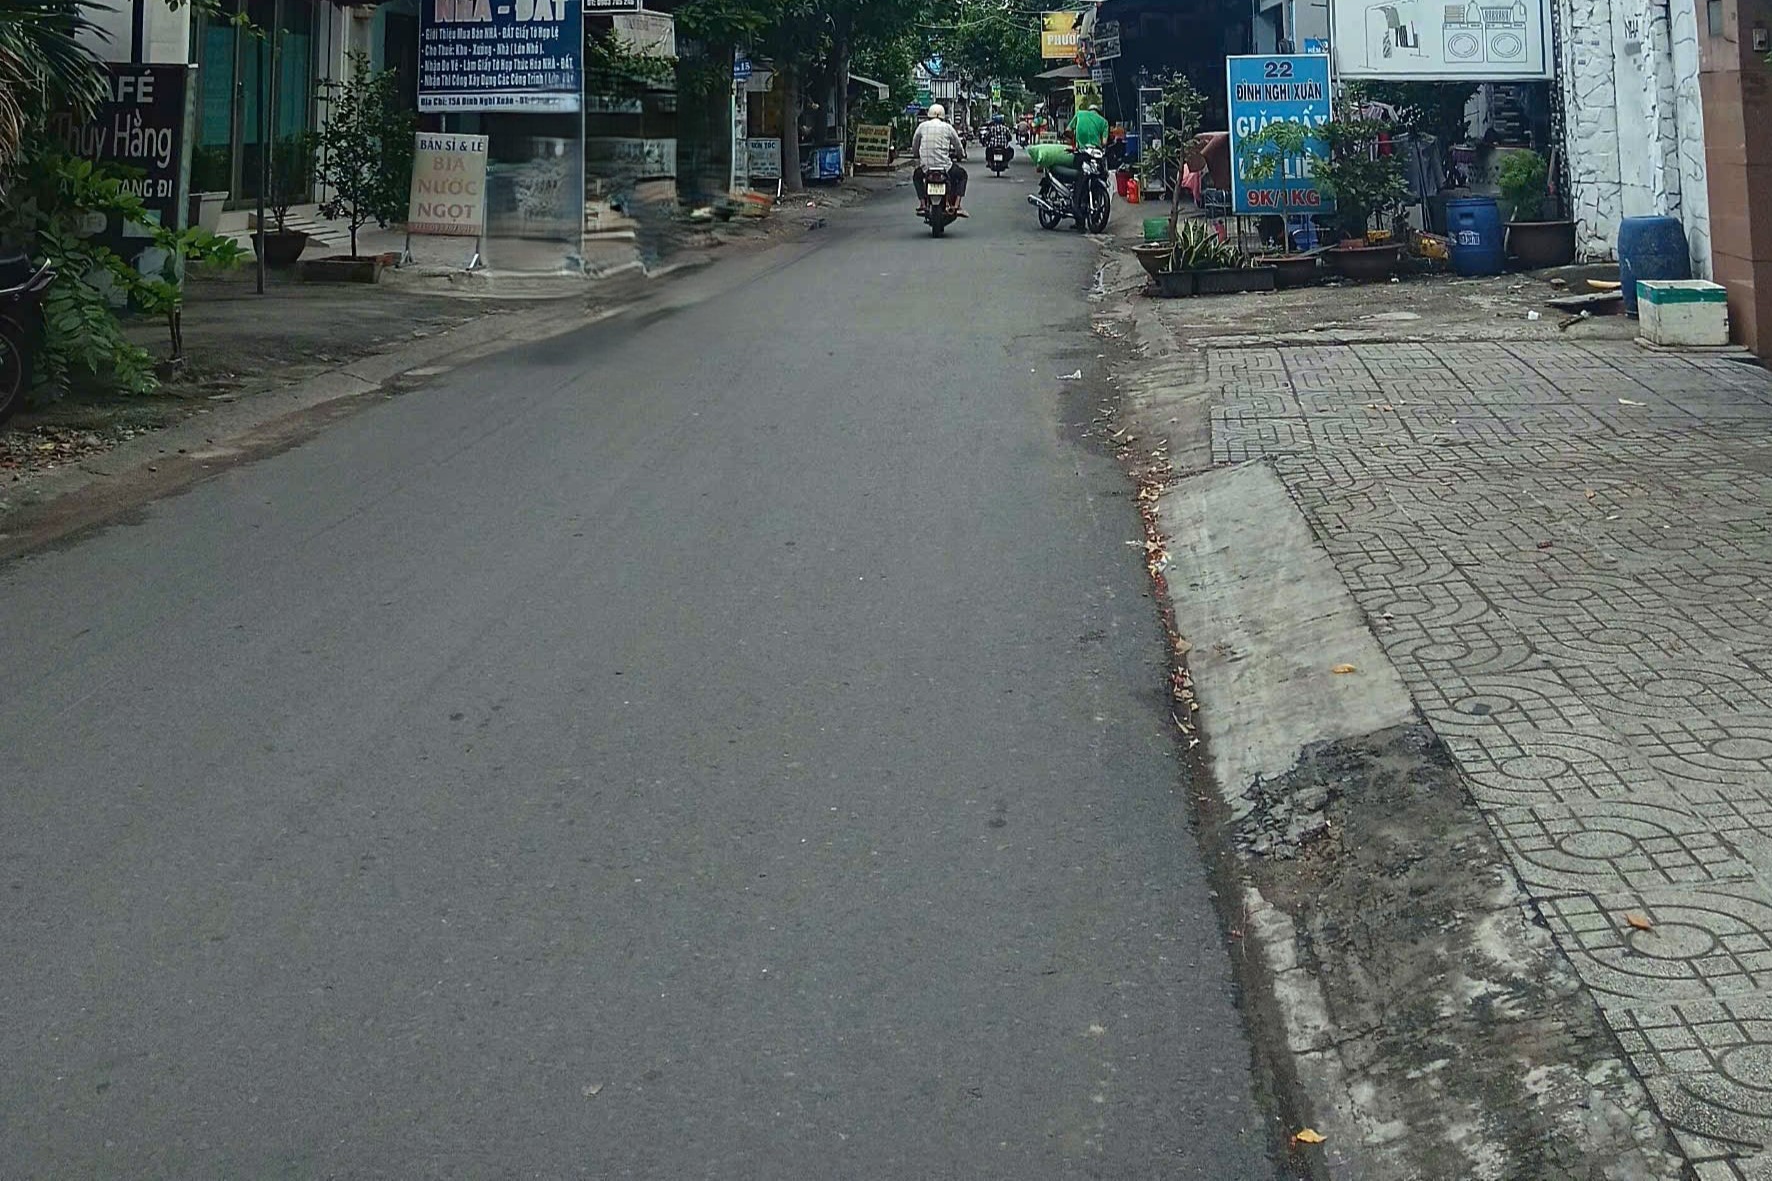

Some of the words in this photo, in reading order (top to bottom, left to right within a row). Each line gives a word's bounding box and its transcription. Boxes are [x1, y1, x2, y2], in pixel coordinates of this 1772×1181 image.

[1263, 60, 1294, 79] 22
[94, 69, 155, 104] AFÉ
[1235, 78, 1262, 102] ĐÌNH
[1264, 84, 1291, 102] NGHI
[1292, 78, 1323, 102] XUÂN
[112, 108, 173, 169] Hằng
[420, 136, 442, 152] BÁN
[459, 142, 468, 152] &
[432, 156, 466, 172] BIA
[114, 178, 153, 198] ANG
[156, 179, 173, 198] ĐI
[417, 176, 478, 196] NƯỚC
[417, 203, 477, 222] NGỌT
